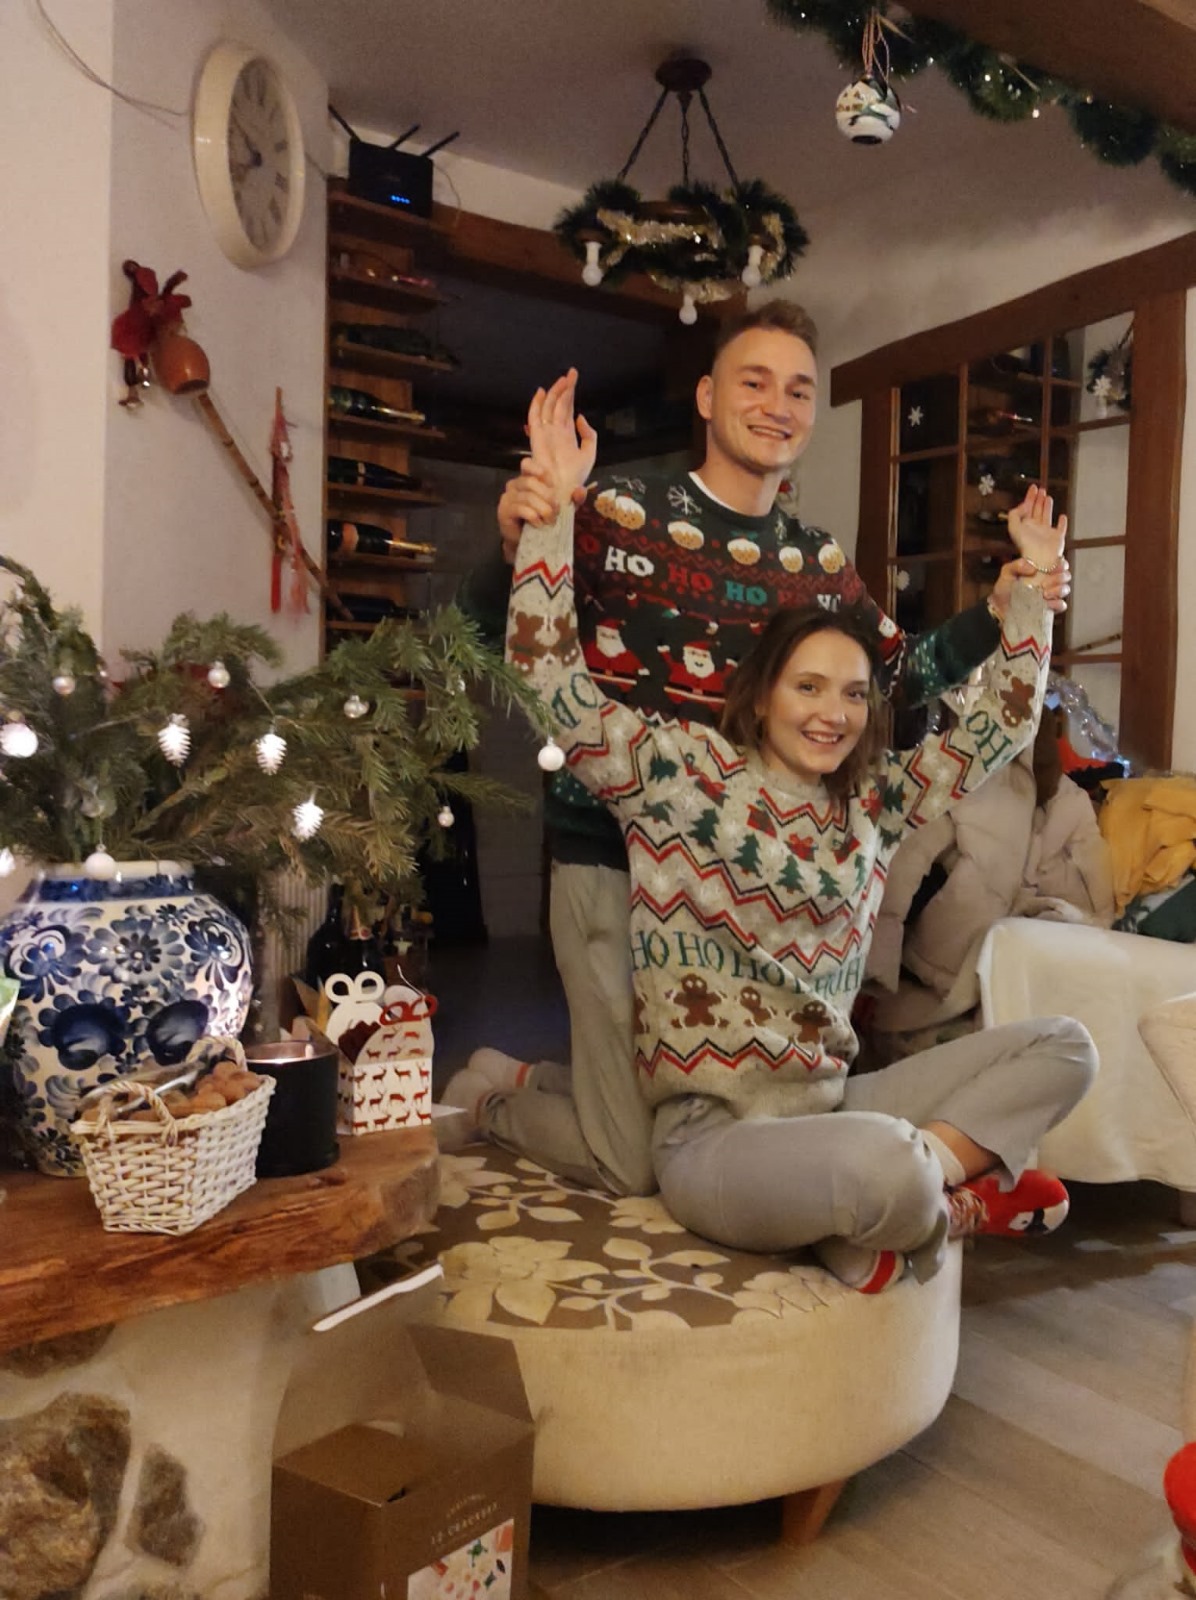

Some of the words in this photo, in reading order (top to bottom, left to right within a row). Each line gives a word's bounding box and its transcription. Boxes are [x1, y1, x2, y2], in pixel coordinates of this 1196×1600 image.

[604, 545, 655, 577] HO
[667, 561, 713, 592] HO
[725, 580, 768, 605] HO
[631, 928, 669, 971] HO
[673, 930, 724, 974] HO
